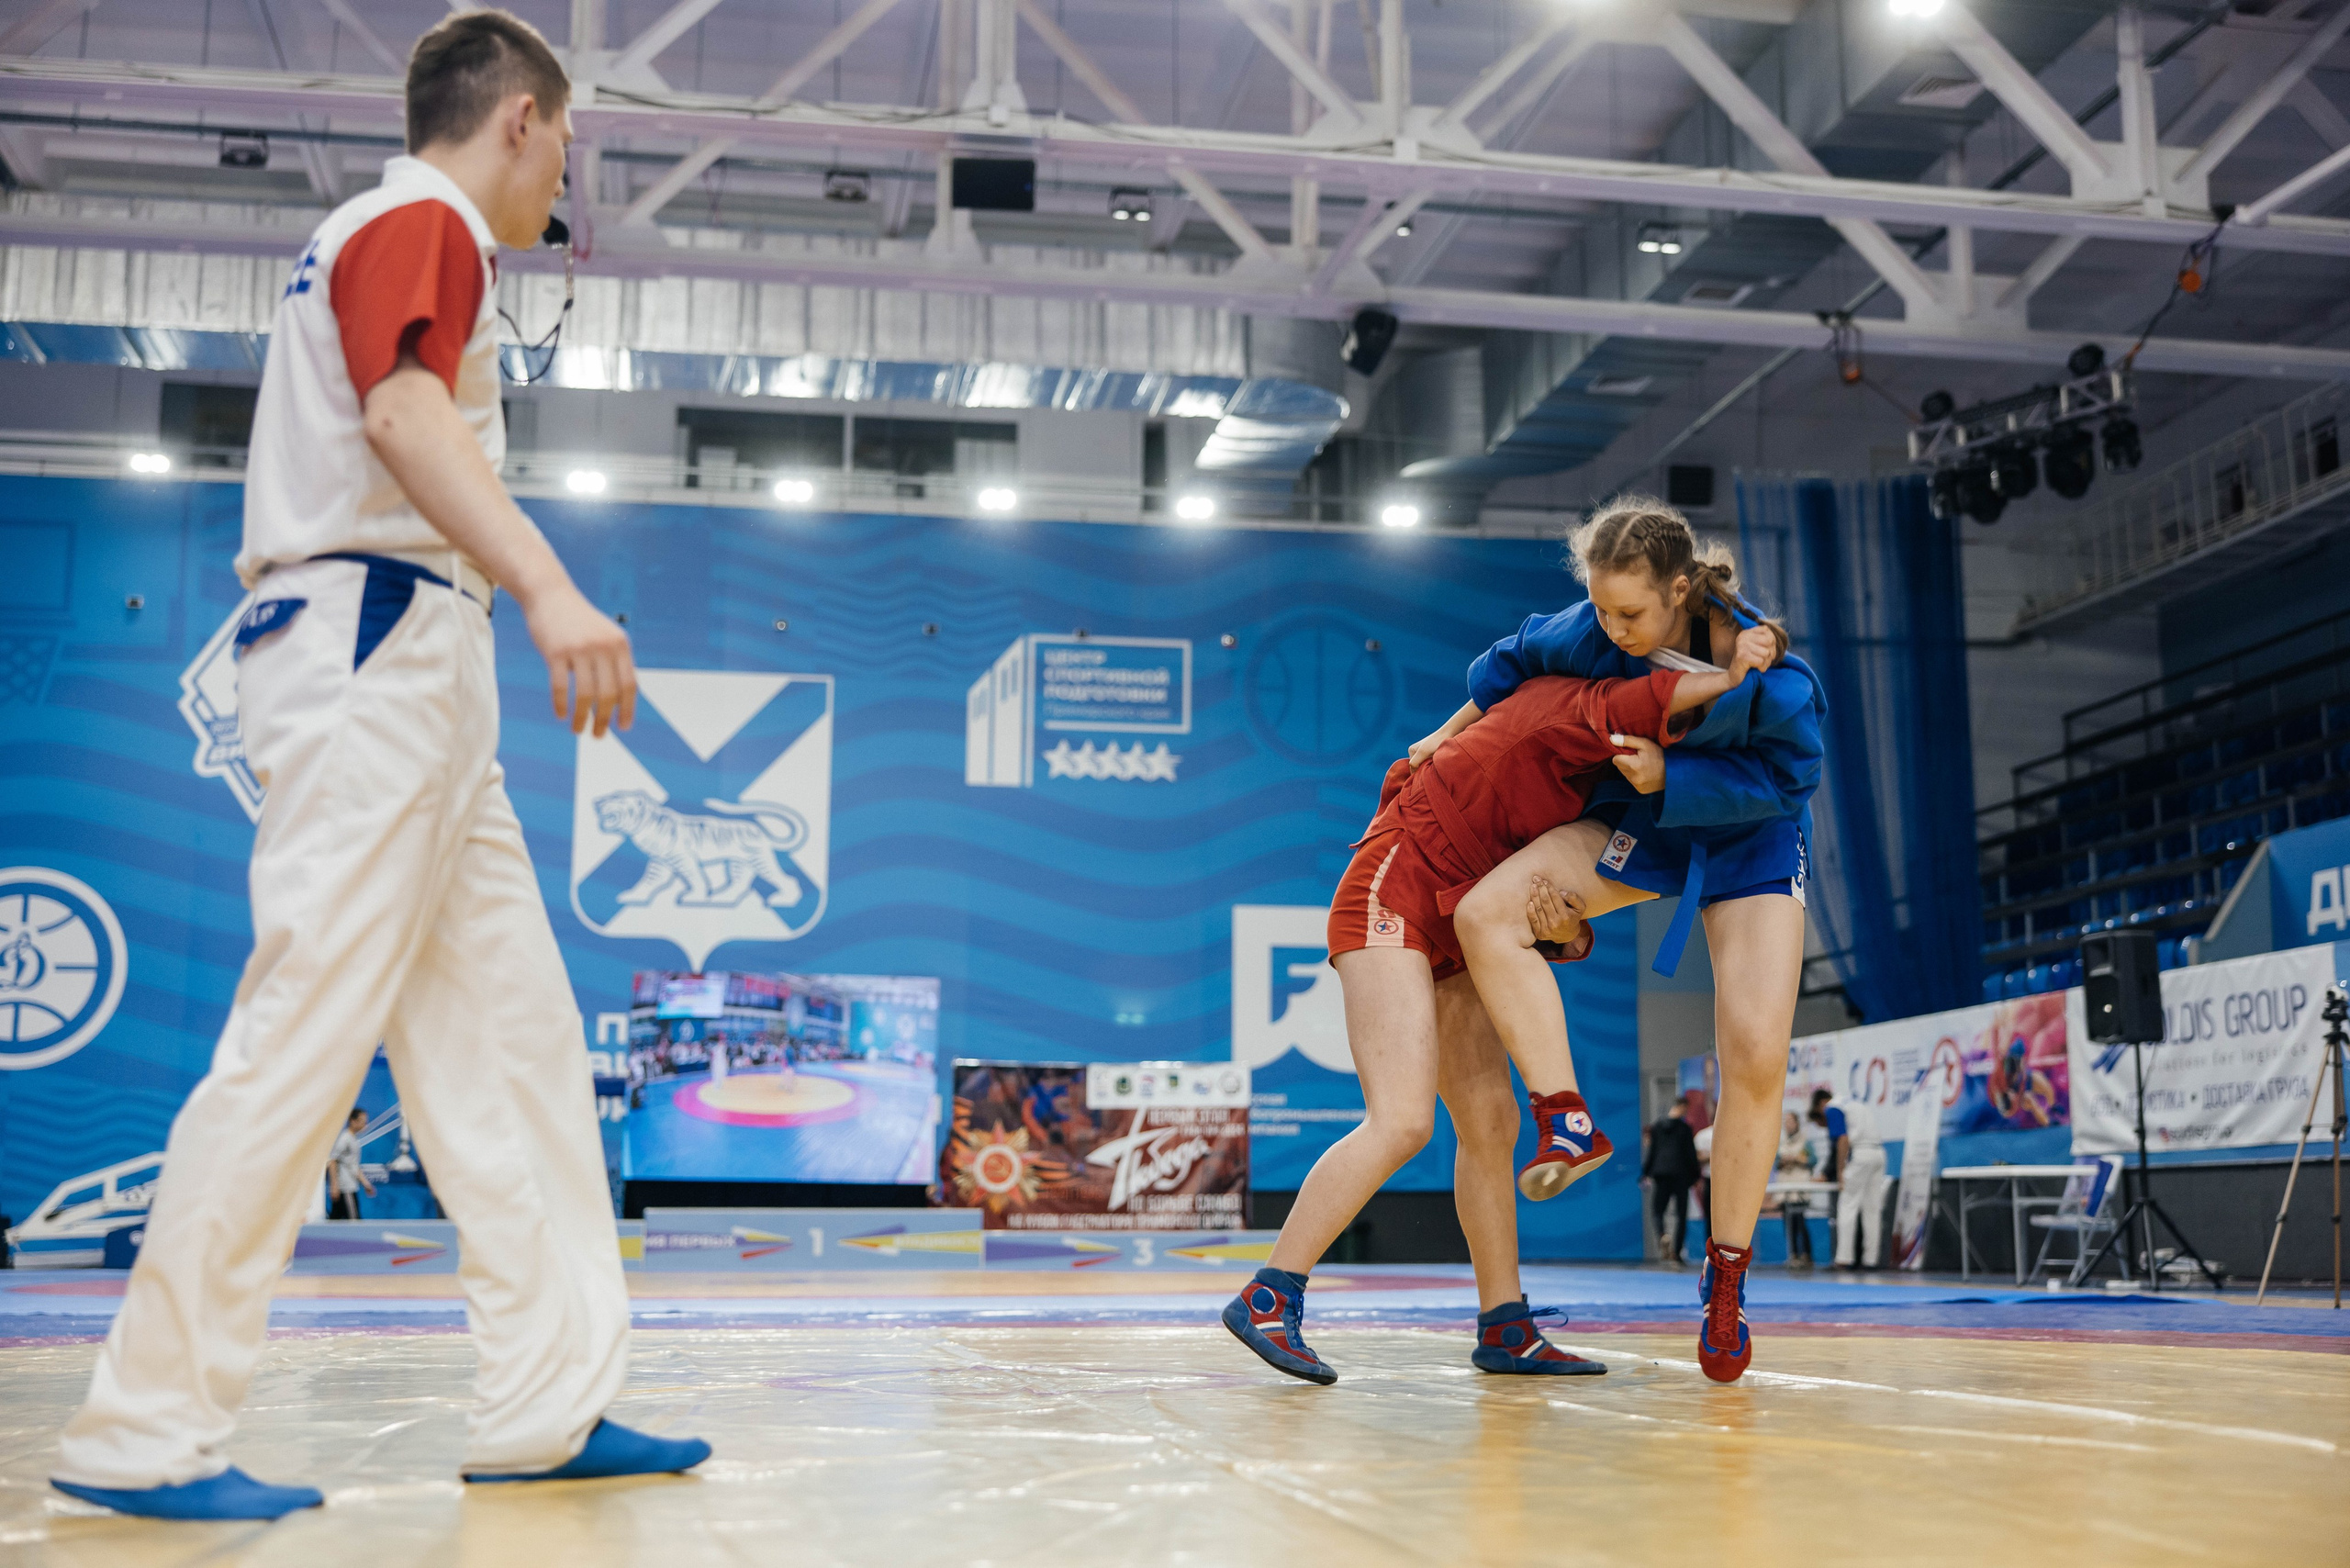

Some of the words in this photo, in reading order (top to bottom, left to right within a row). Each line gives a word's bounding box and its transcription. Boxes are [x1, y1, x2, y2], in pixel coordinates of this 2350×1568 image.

[2223, 982, 2307, 1037] GROUP
[808, 1227, 824, 1258] 1
[1132, 1238, 1154, 1266] 3
